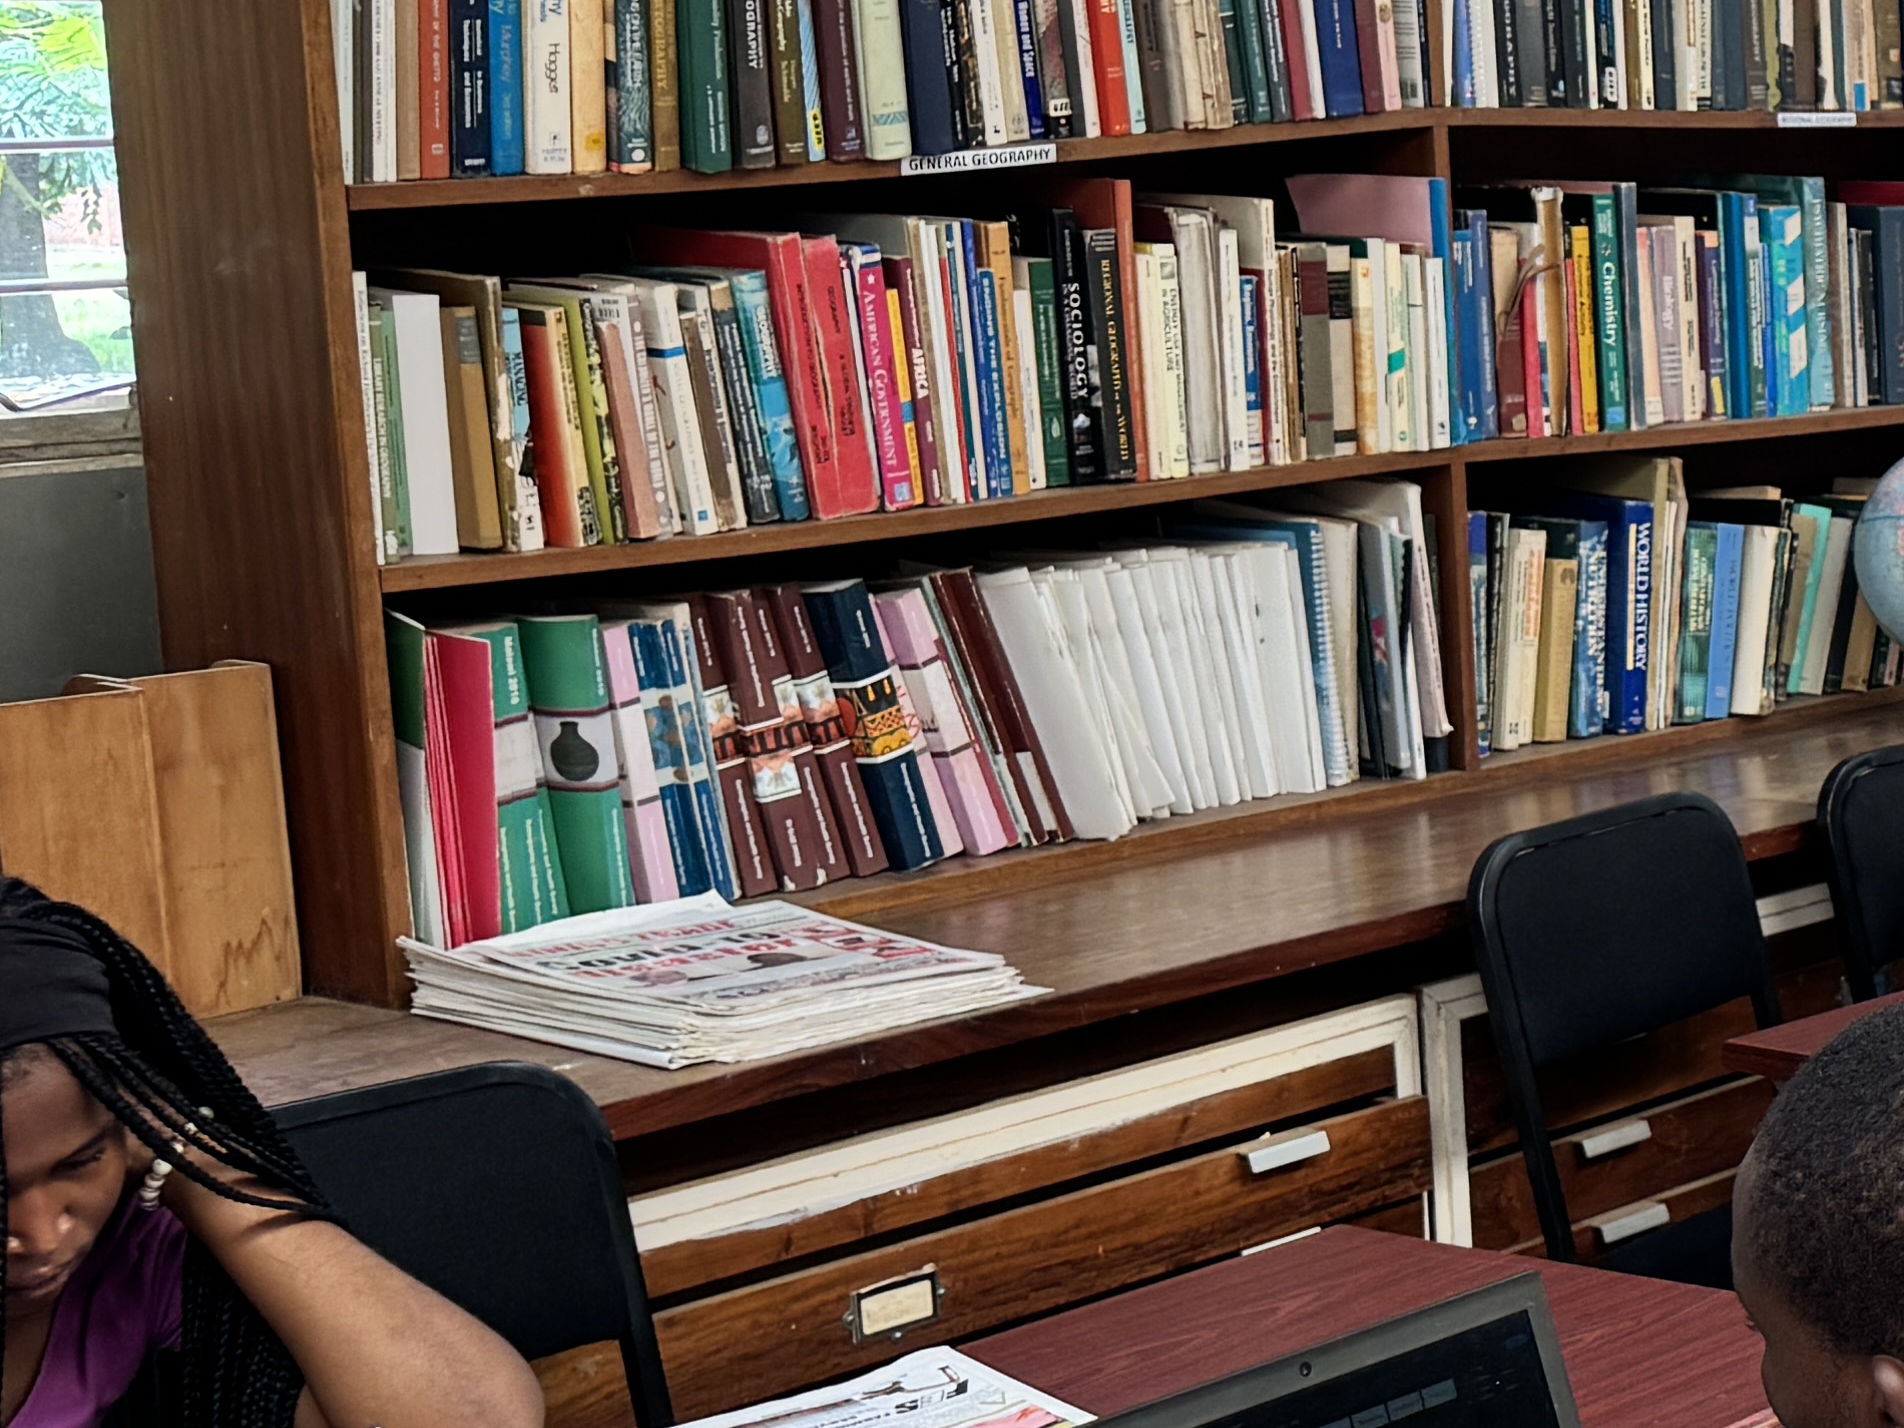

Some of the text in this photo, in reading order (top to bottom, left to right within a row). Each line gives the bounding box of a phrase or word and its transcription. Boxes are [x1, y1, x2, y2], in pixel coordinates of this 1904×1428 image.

[1017, 2, 1031, 33] Women
[1020, 34, 1032, 50] and
[500, 24, 514, 83] Murphey
[713, 30, 723, 80] Production
[1022, 51, 1035, 78] Space
[909, 148, 1052, 172] GENERAL GEOGRAPHY
[827, 285, 842, 334] GEOGRAPHY
[1602, 262, 1618, 346] Chemistry
[1662, 275, 1675, 331] Biology
[757, 305, 778, 378] GEOGRAPHY
[988, 341, 999, 368] THE
[1069, 282, 1089, 399] SOCIOLOGY
[1100, 259, 1130, 460] REGIONAL GEOGRAPHY WORLD
[1161, 300, 1174, 372] AGRICULTURE
[512, 352, 529, 406] MANAGING
[863, 291, 897, 467] AMERICAN GOVERNMENT
[912, 348, 928, 399] AFRICA
[373, 358, 391, 498] LIBRARY RESEARCH IN GEOGRAPHY
[991, 372, 1006, 459] EXPLOSION
[1587, 550, 1599, 656] NUTRITION
[1635, 522, 1651, 670] WORLD HISTORY
